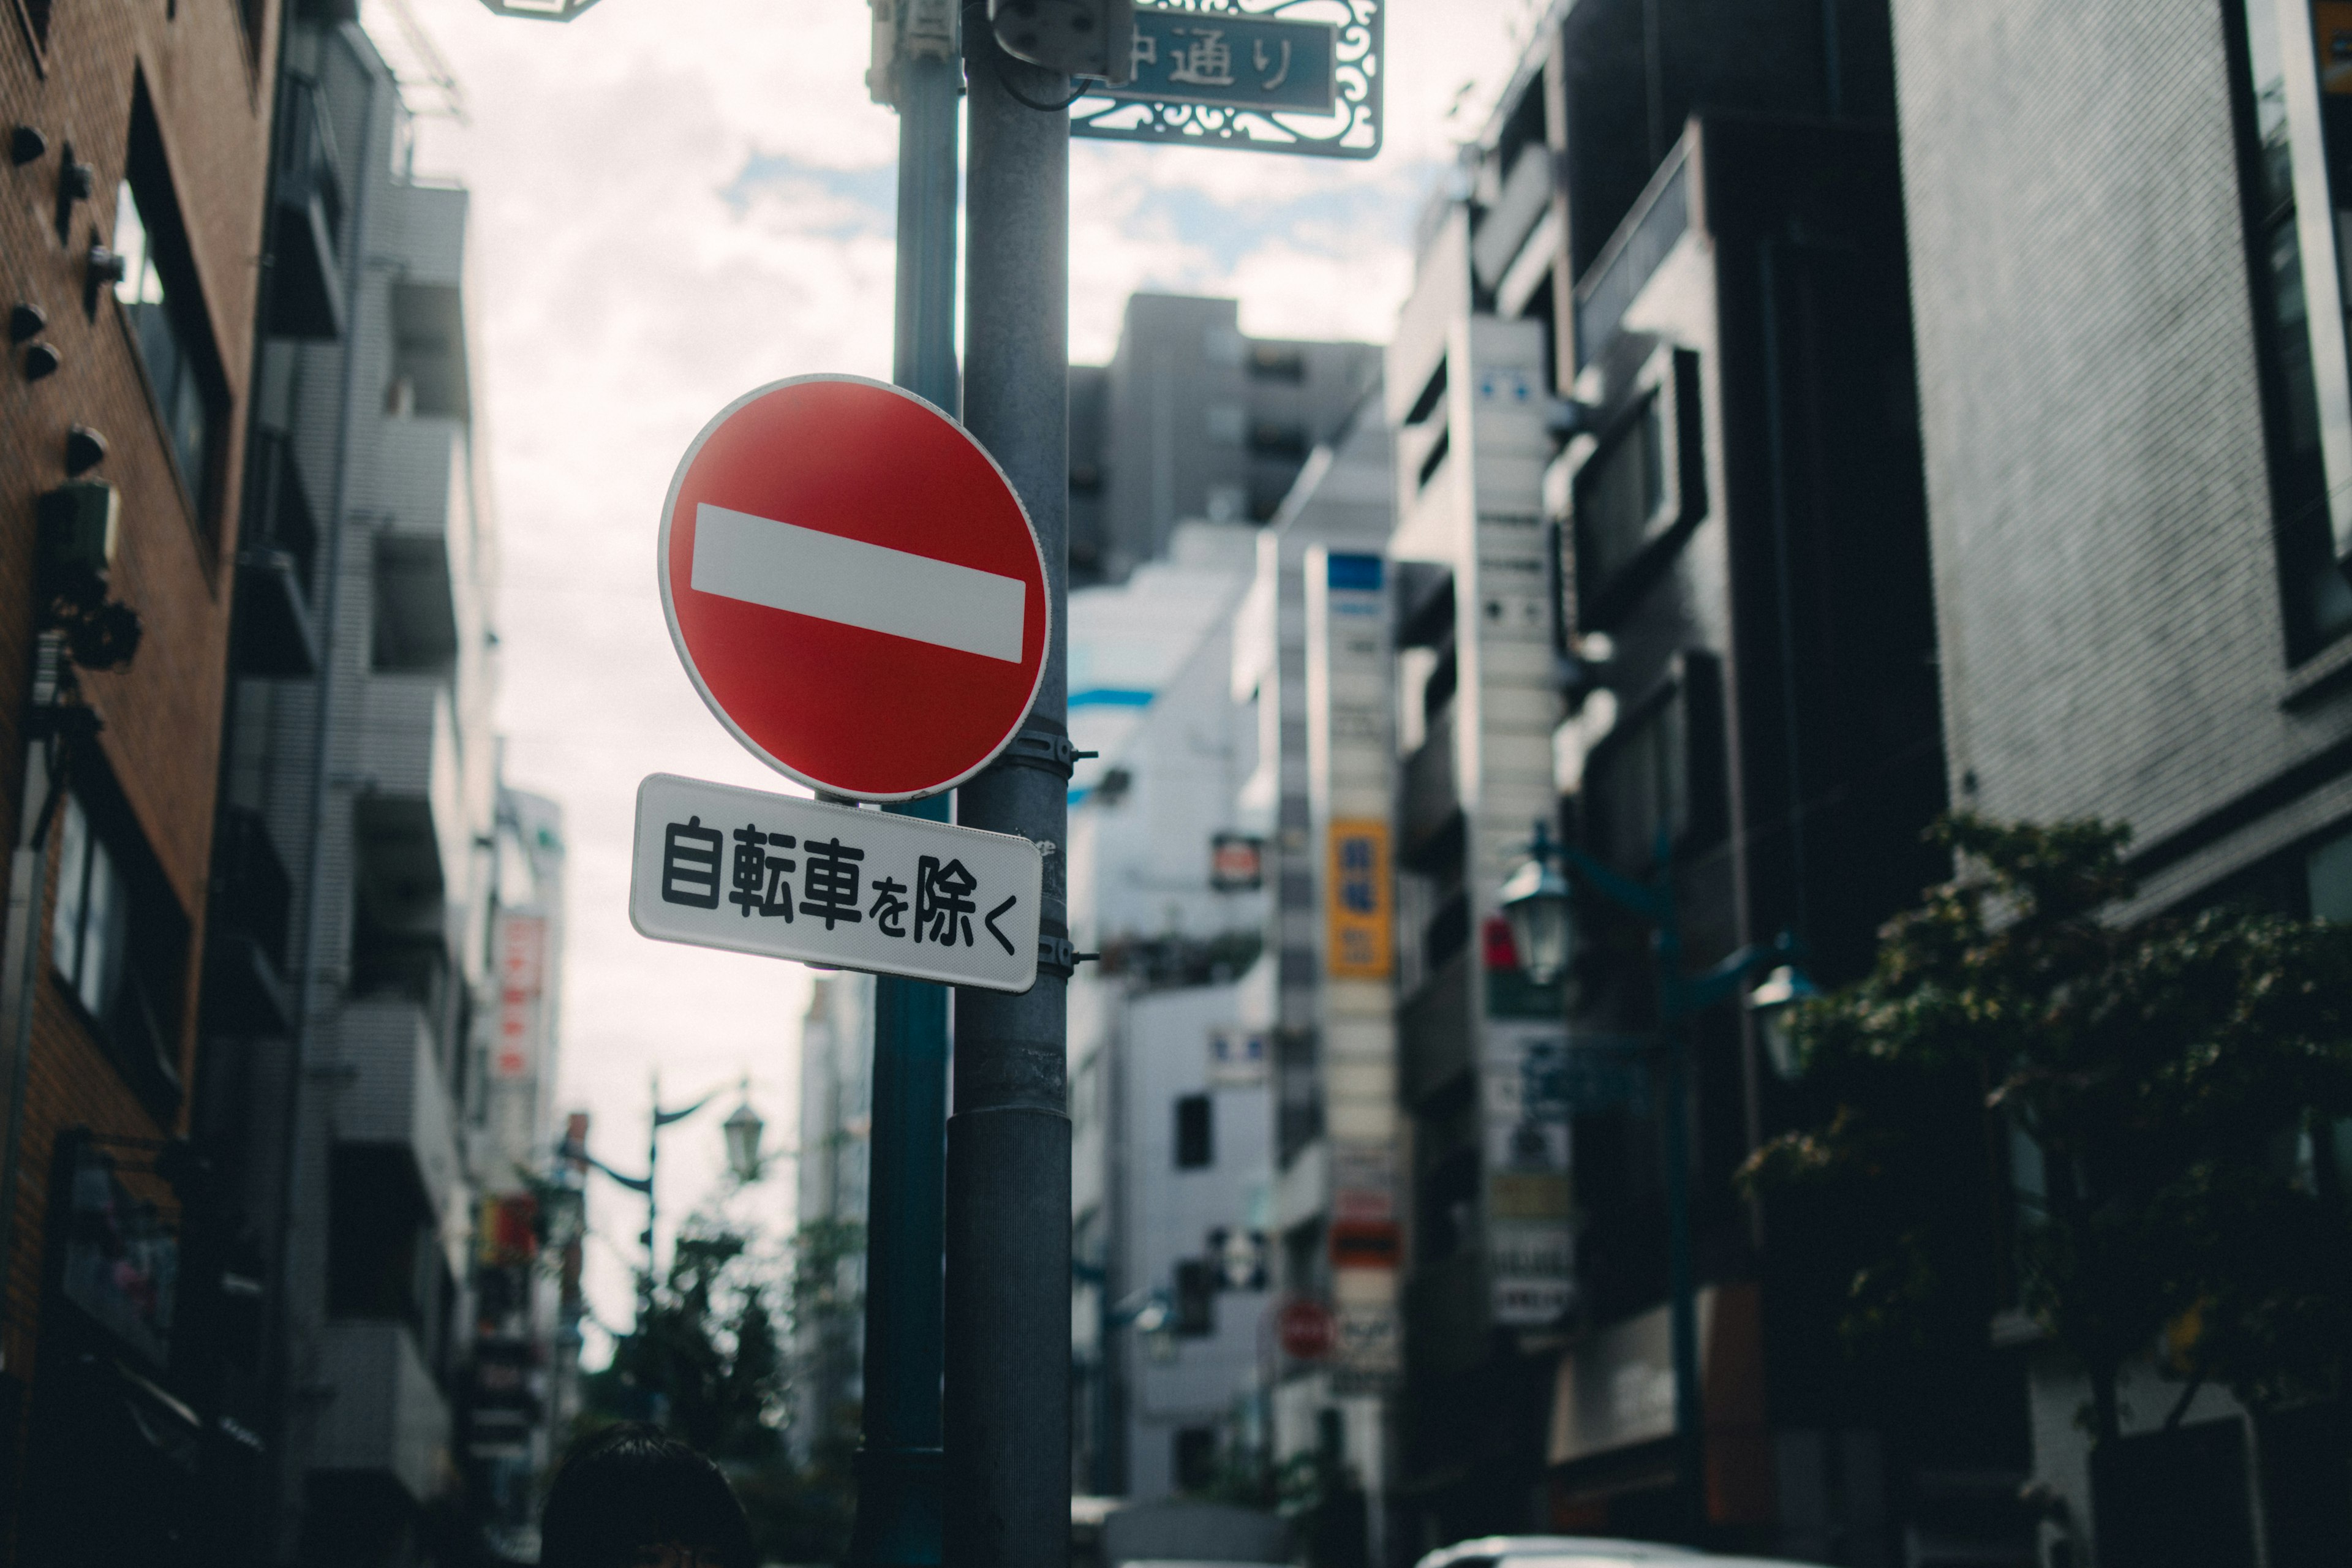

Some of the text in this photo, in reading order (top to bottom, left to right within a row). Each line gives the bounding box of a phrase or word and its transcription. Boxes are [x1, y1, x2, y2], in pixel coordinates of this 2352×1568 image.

[662, 815, 1017, 957] 自転車を除く
